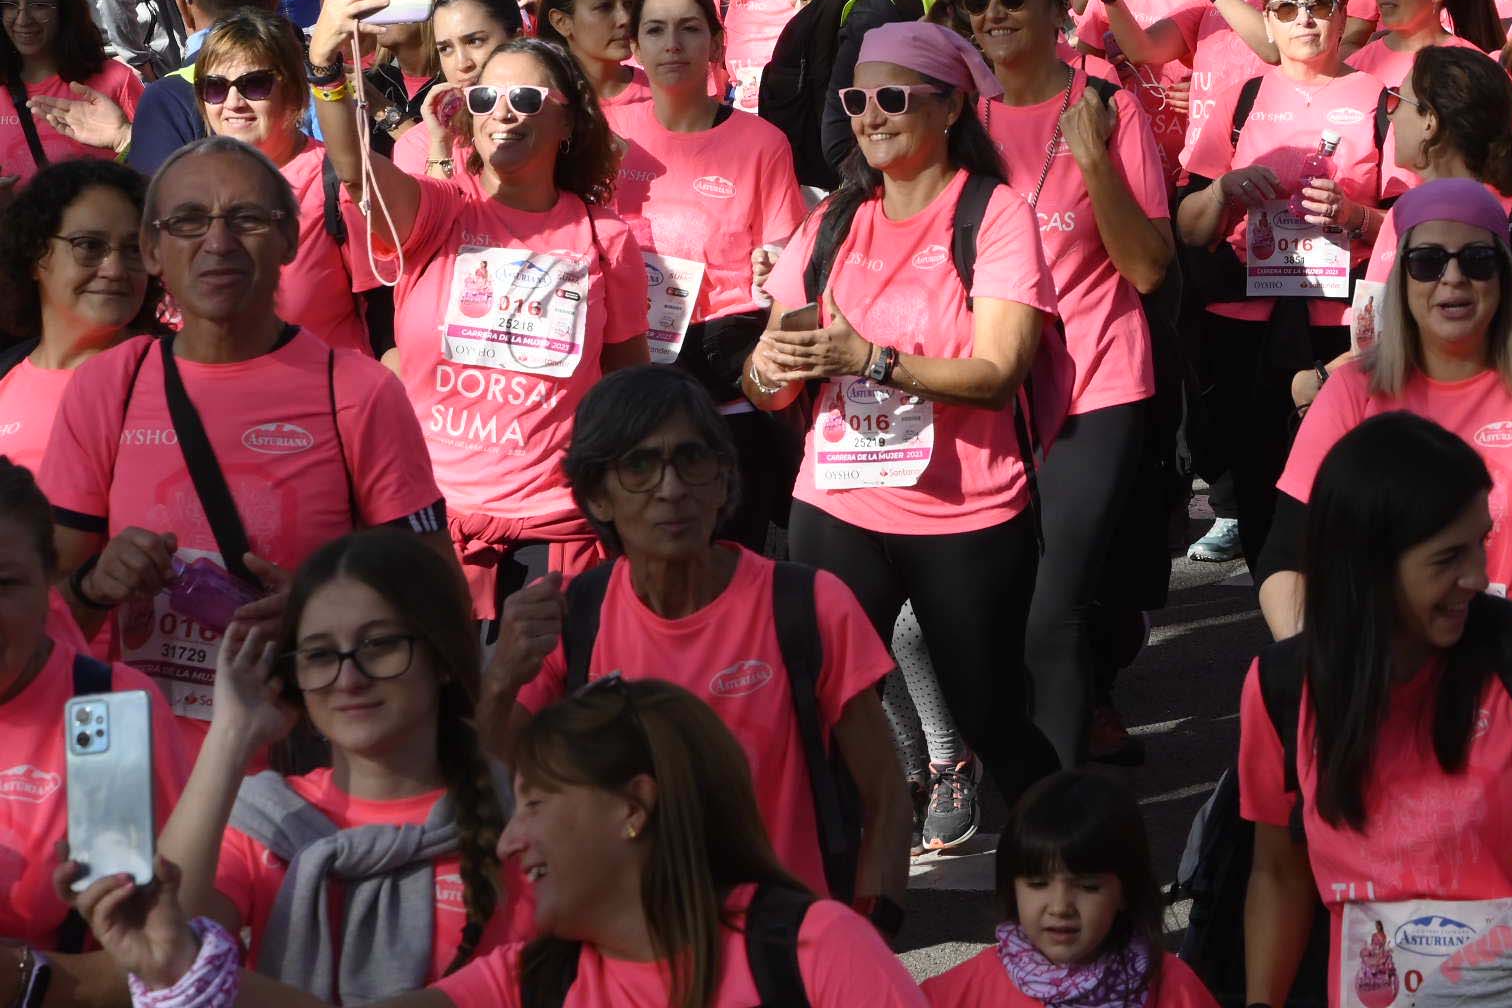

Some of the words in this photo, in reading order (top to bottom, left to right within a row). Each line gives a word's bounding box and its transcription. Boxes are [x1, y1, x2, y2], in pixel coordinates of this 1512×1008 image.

[1037, 211, 1075, 232] CAS
[1278, 238, 1313, 251] 016
[498, 295, 545, 317] 016
[498, 317, 534, 332] 25218
[461, 329, 498, 342] CARRERA
[430, 403, 525, 446] SUMA
[850, 414, 890, 431] 016
[250, 433, 308, 447] ASTURIANA
[854, 437, 886, 448] 25219
[825, 470, 860, 480] OYSHO
[161, 643, 207, 662] 31729
[191, 671, 216, 681] MUJ
